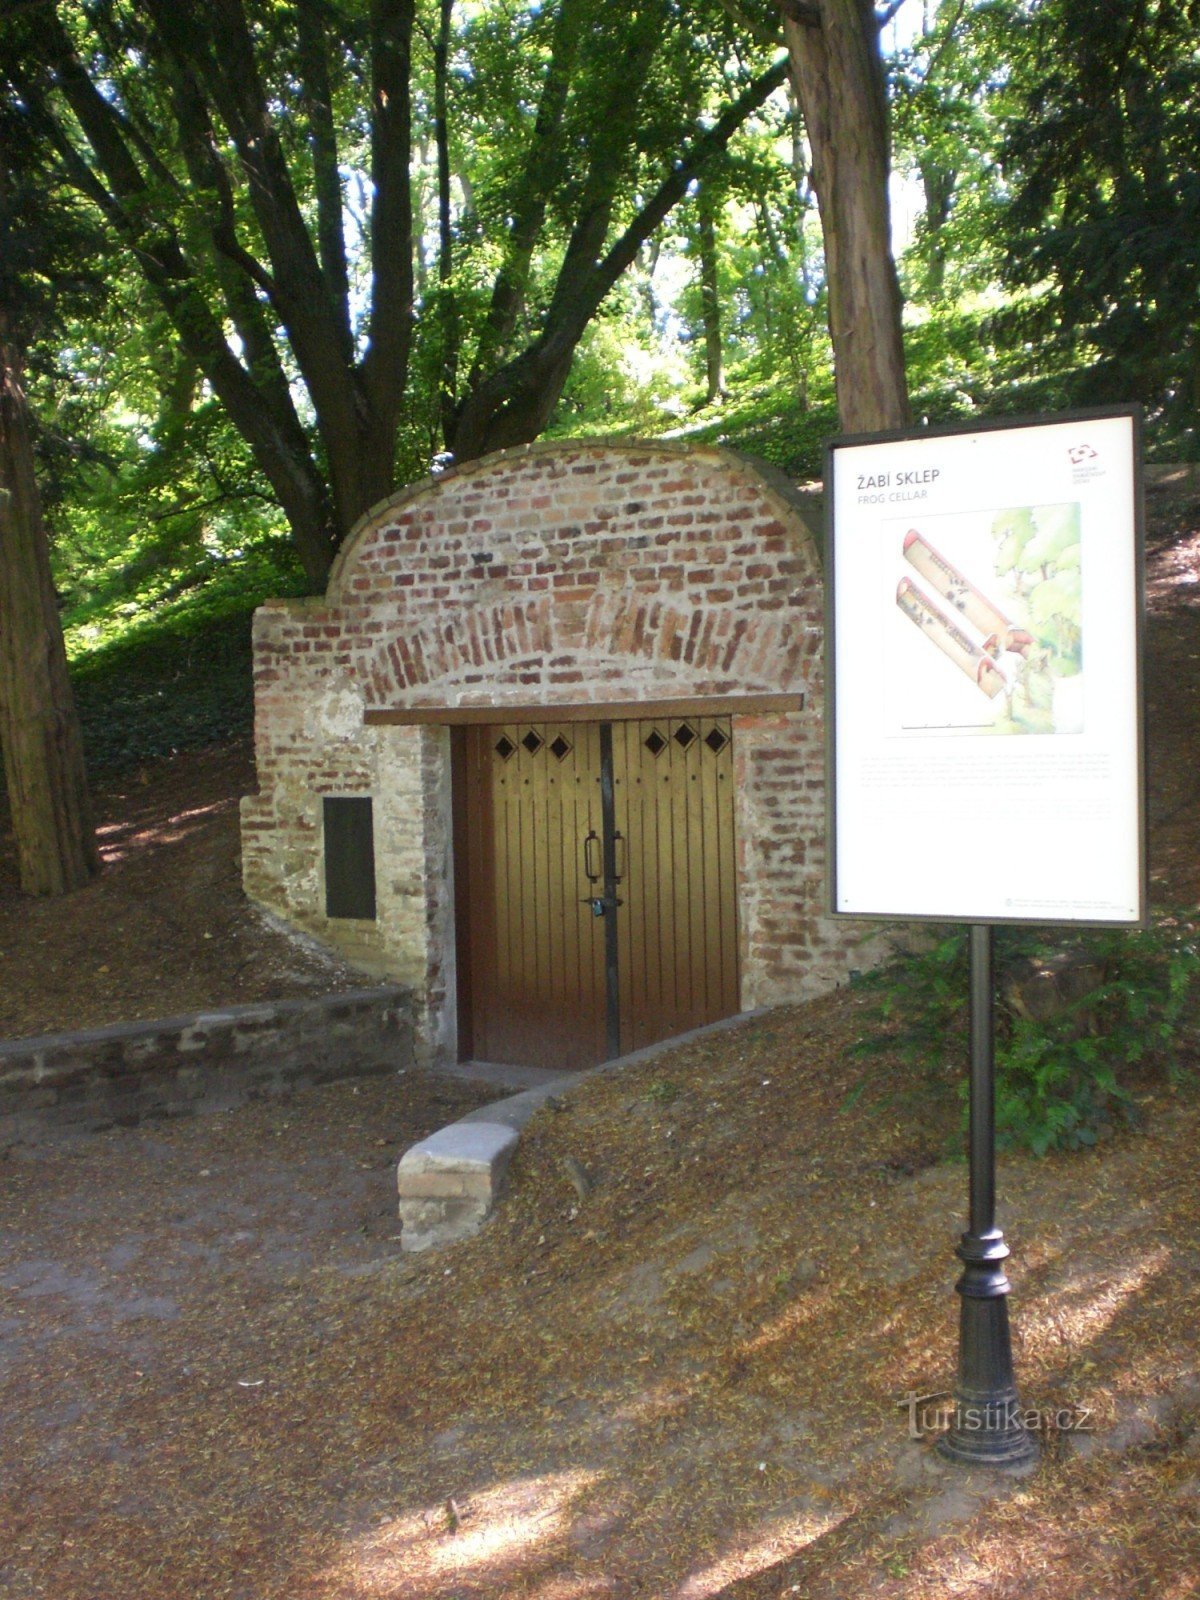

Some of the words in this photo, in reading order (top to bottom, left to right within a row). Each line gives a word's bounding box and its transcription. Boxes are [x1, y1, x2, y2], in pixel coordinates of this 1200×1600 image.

[857, 472, 890, 490] ŽABÍ
[896, 469, 940, 486] SKLEP
[858, 493, 885, 504] FROG
[889, 489, 928, 502] CELLAR
